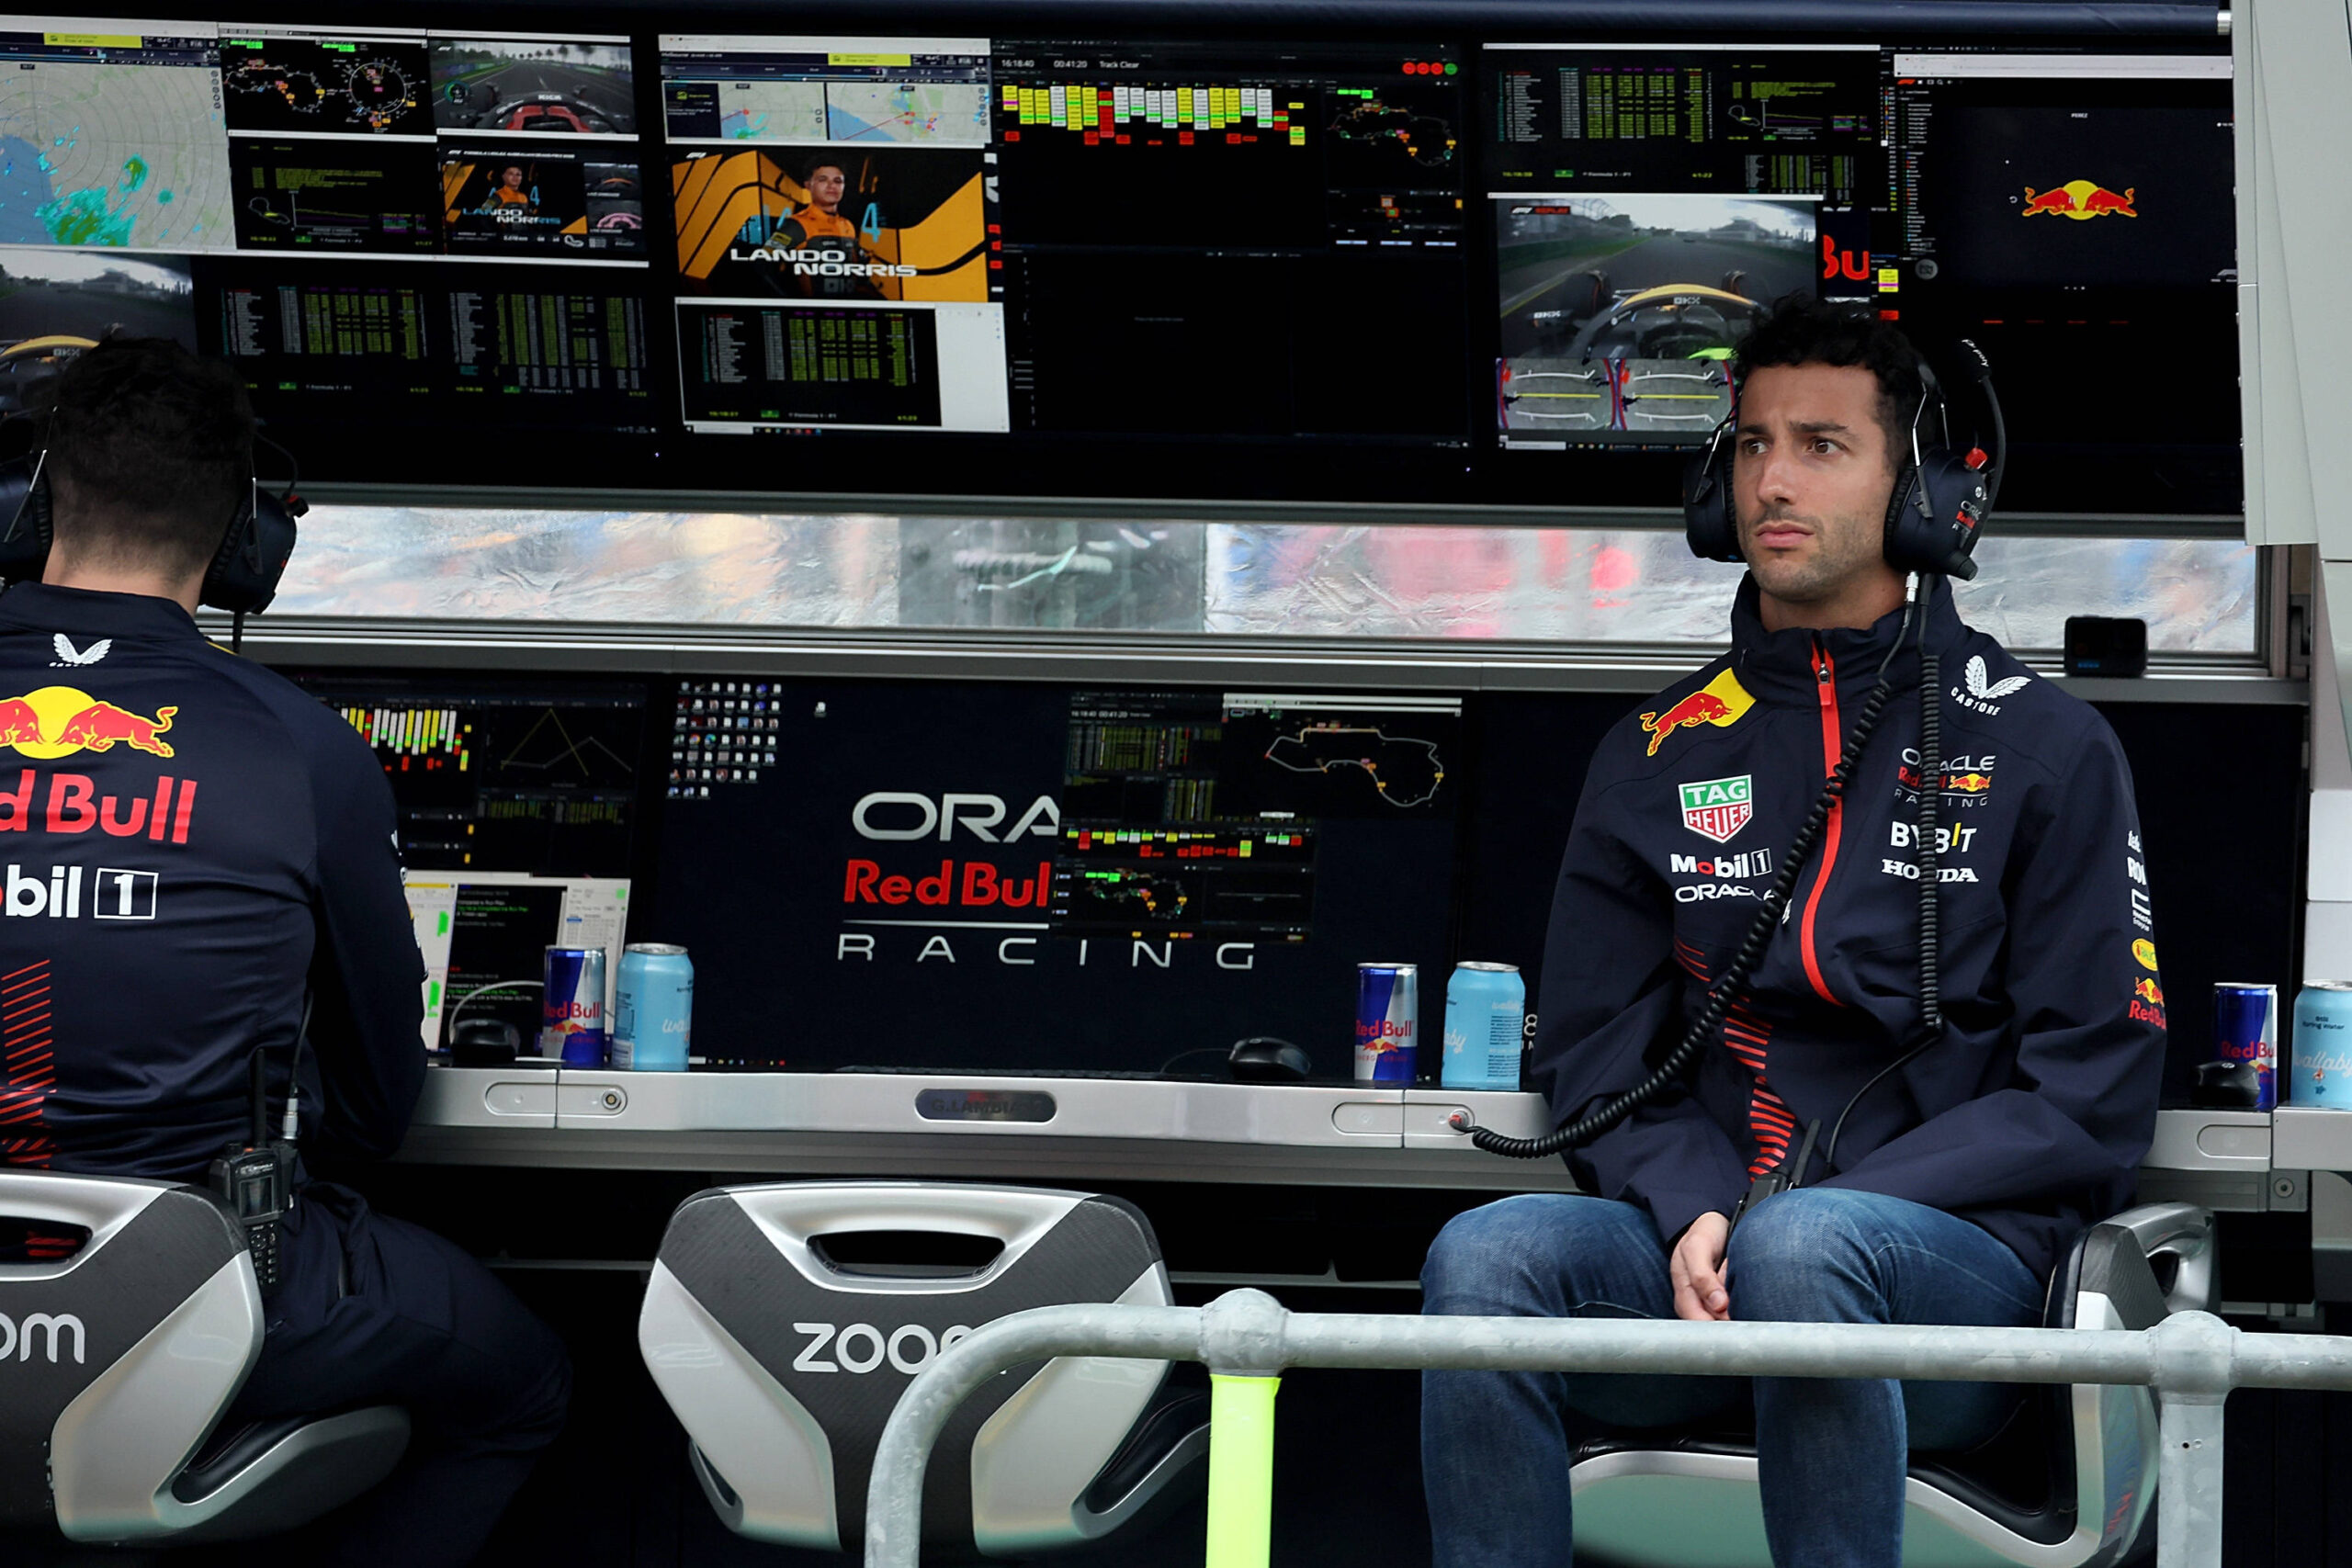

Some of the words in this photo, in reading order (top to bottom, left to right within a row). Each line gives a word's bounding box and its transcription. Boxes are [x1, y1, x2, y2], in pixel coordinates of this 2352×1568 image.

[730, 249, 845, 262] LANDO
[794, 263, 918, 276] NORRIS
[1951, 686, 2001, 716] CASTORE
[1901, 747, 1996, 773] OACLE
[1685, 780, 1747, 806] TAG
[1894, 788, 1989, 808] RAING
[46, 773, 198, 844] Bull
[1687, 803, 1751, 839] HEUER
[1670, 853, 1749, 879] Mobil
[1881, 858, 1980, 883] HODA
[0, 864, 83, 919] bil
[843, 859, 952, 905] Red
[838, 933, 1254, 970] RACING
[571, 1001, 601, 1019] Bull
[1382, 1020, 1412, 1037] Bull
[2221, 1041, 2255, 1059] Red
